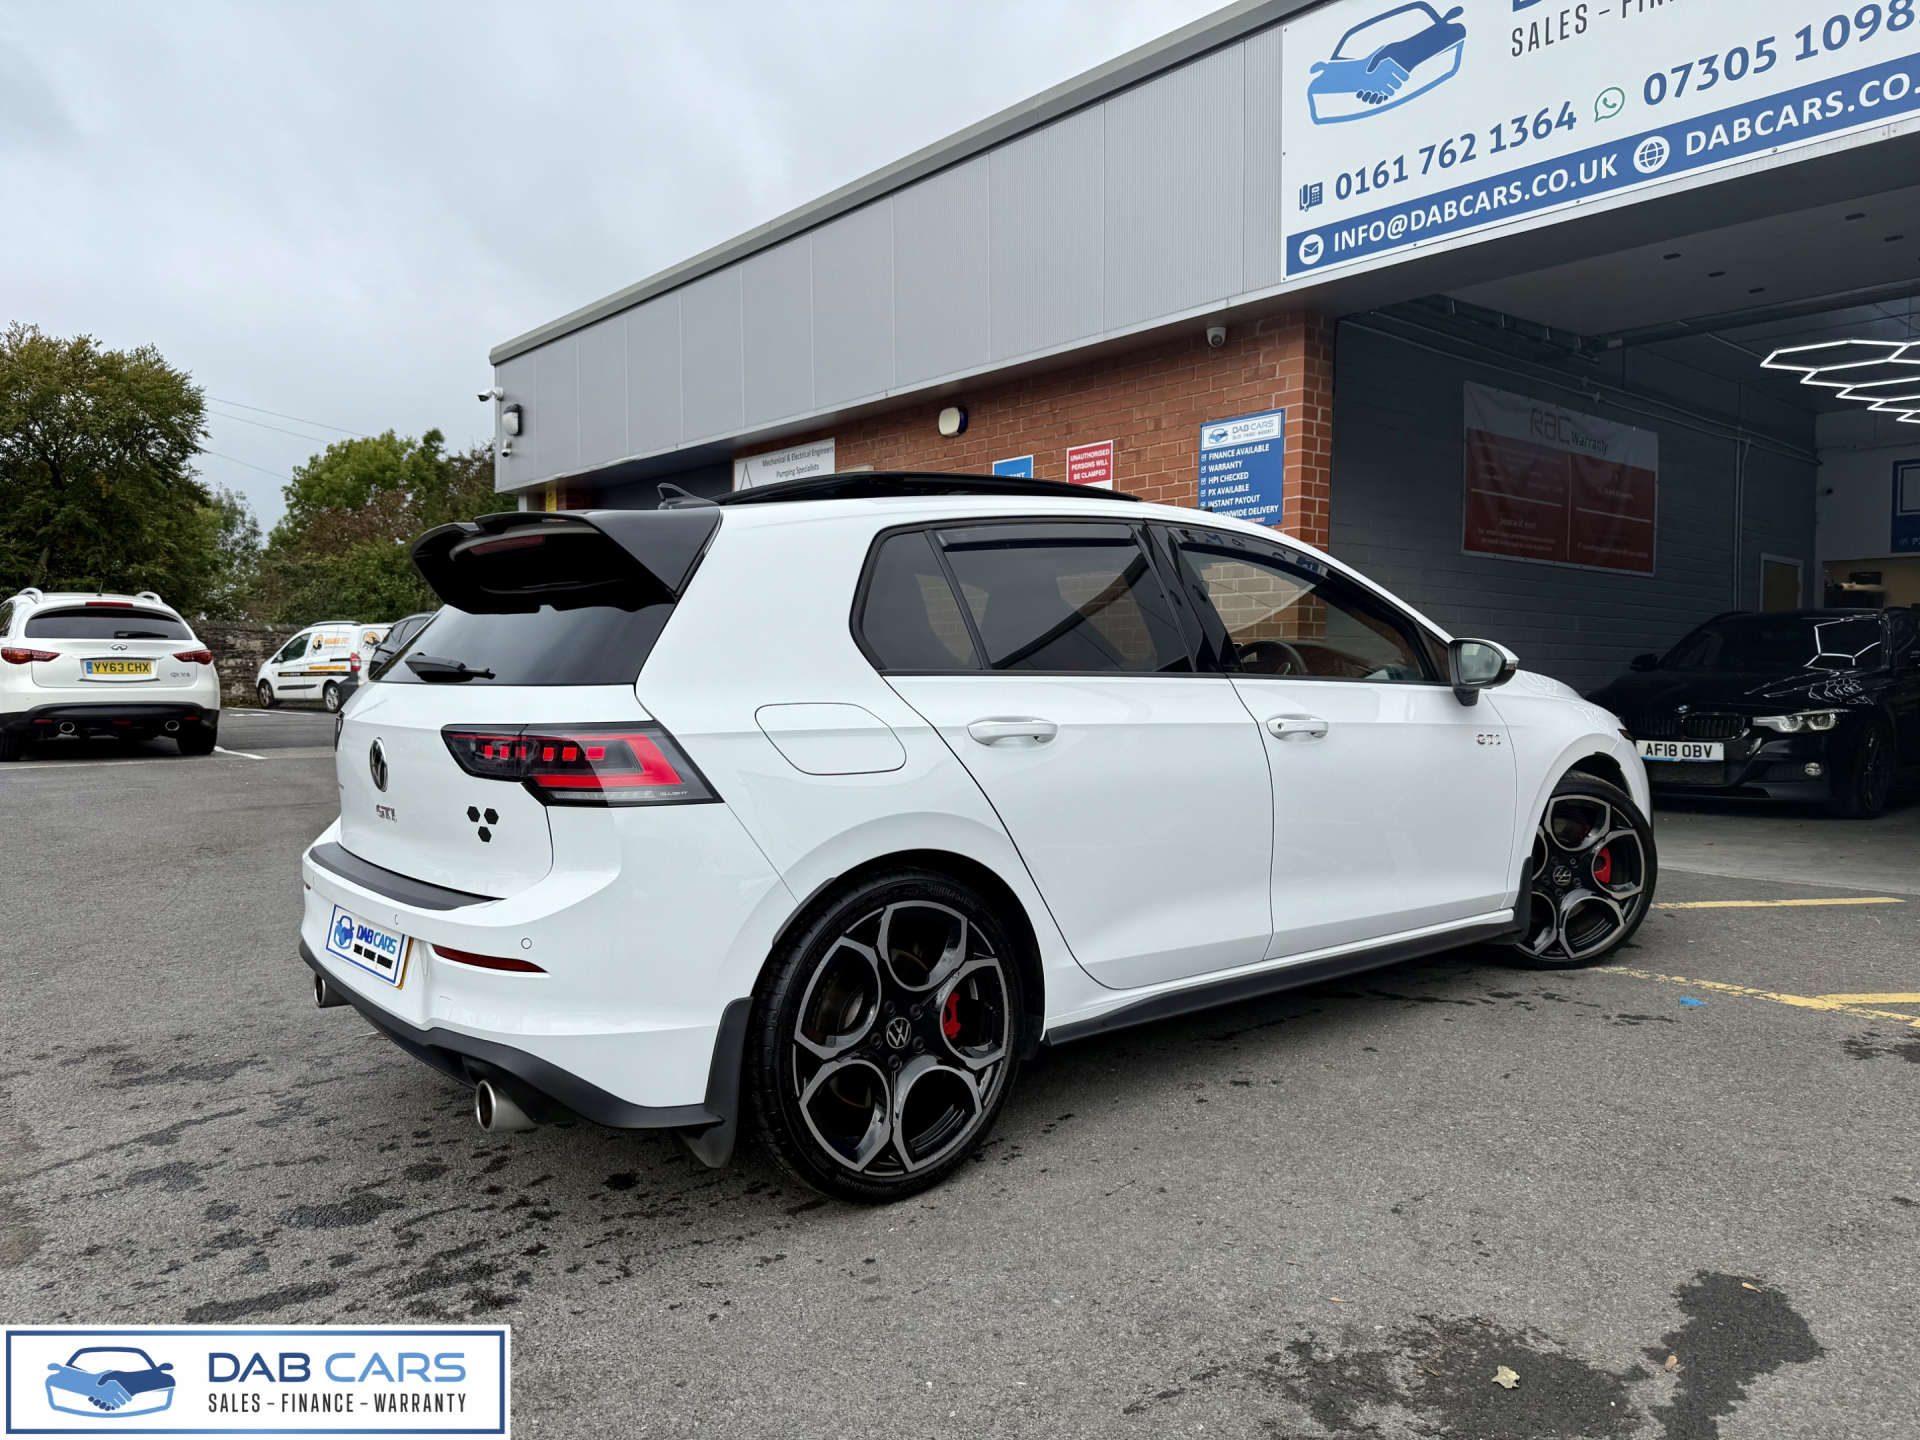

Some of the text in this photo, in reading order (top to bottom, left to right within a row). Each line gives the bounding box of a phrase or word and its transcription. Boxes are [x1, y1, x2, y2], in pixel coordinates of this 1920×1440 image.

[1511, 3, 1588, 57] SALES
[1643, 0, 1920, 105] 07305 1098
[1334, 101, 1577, 200] 0161 762 1364
[1333, 153, 1618, 252] INFO@DABCARS.CO.UK
[1570, 431, 1609, 456] Warranty
[1070, 449, 1110, 462] UNAUTHORISED
[1208, 444, 1270, 461] FINANCE AVAILABLE
[1071, 459, 1108, 471] PERSONS WILL
[1208, 460, 1243, 473] WARRANTY
[1081, 469, 1106, 479] CLAMPED
[1208, 471, 1249, 485] HPI CHECKED
[1208, 484, 1250, 497] PX AVAILABLE
[1208, 494, 1261, 508] INSTANT PAYOUT
[1248, 504, 1279, 516] DELIVERY
[93, 662, 150, 672] YY63 CHX
[1645, 743, 1713, 758] AF18 OBV
[356, 924, 397, 955] DAB CARS
